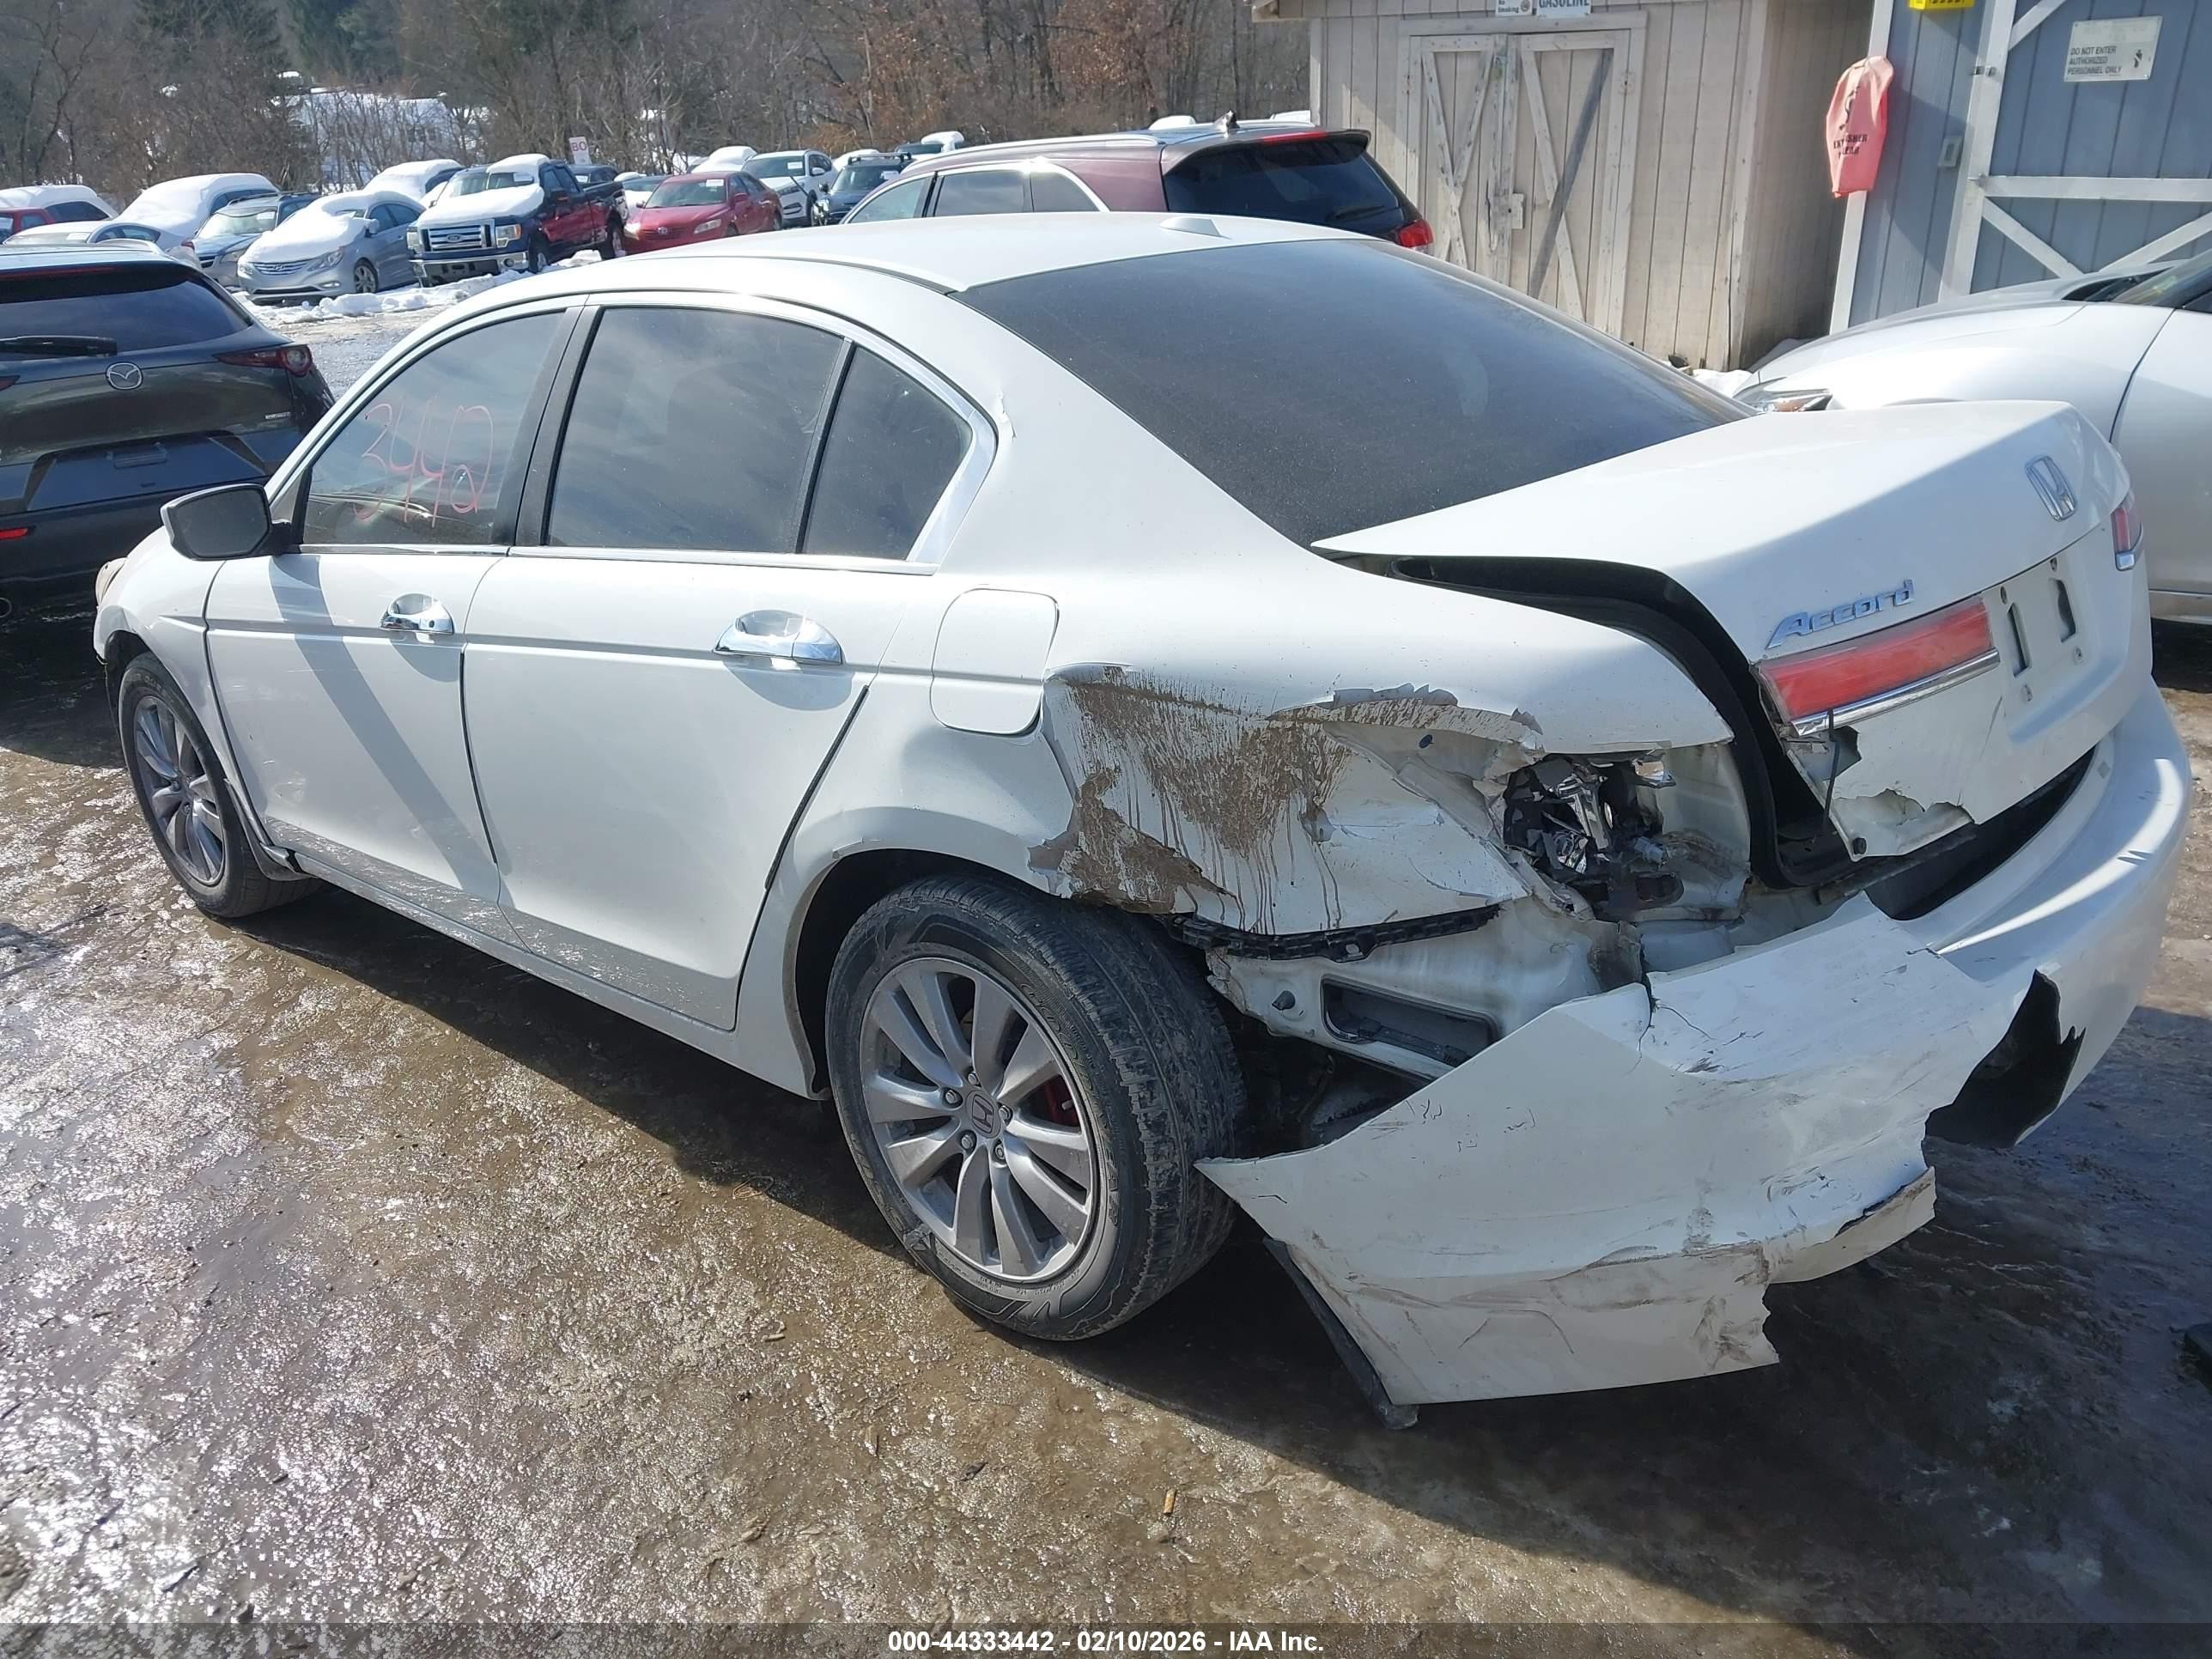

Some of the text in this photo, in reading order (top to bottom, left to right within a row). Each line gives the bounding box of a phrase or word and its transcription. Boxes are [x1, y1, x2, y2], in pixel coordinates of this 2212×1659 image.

[2070, 46, 2117, 56] DO NOT ENTER
[1765, 577, 1916, 650] Accord
